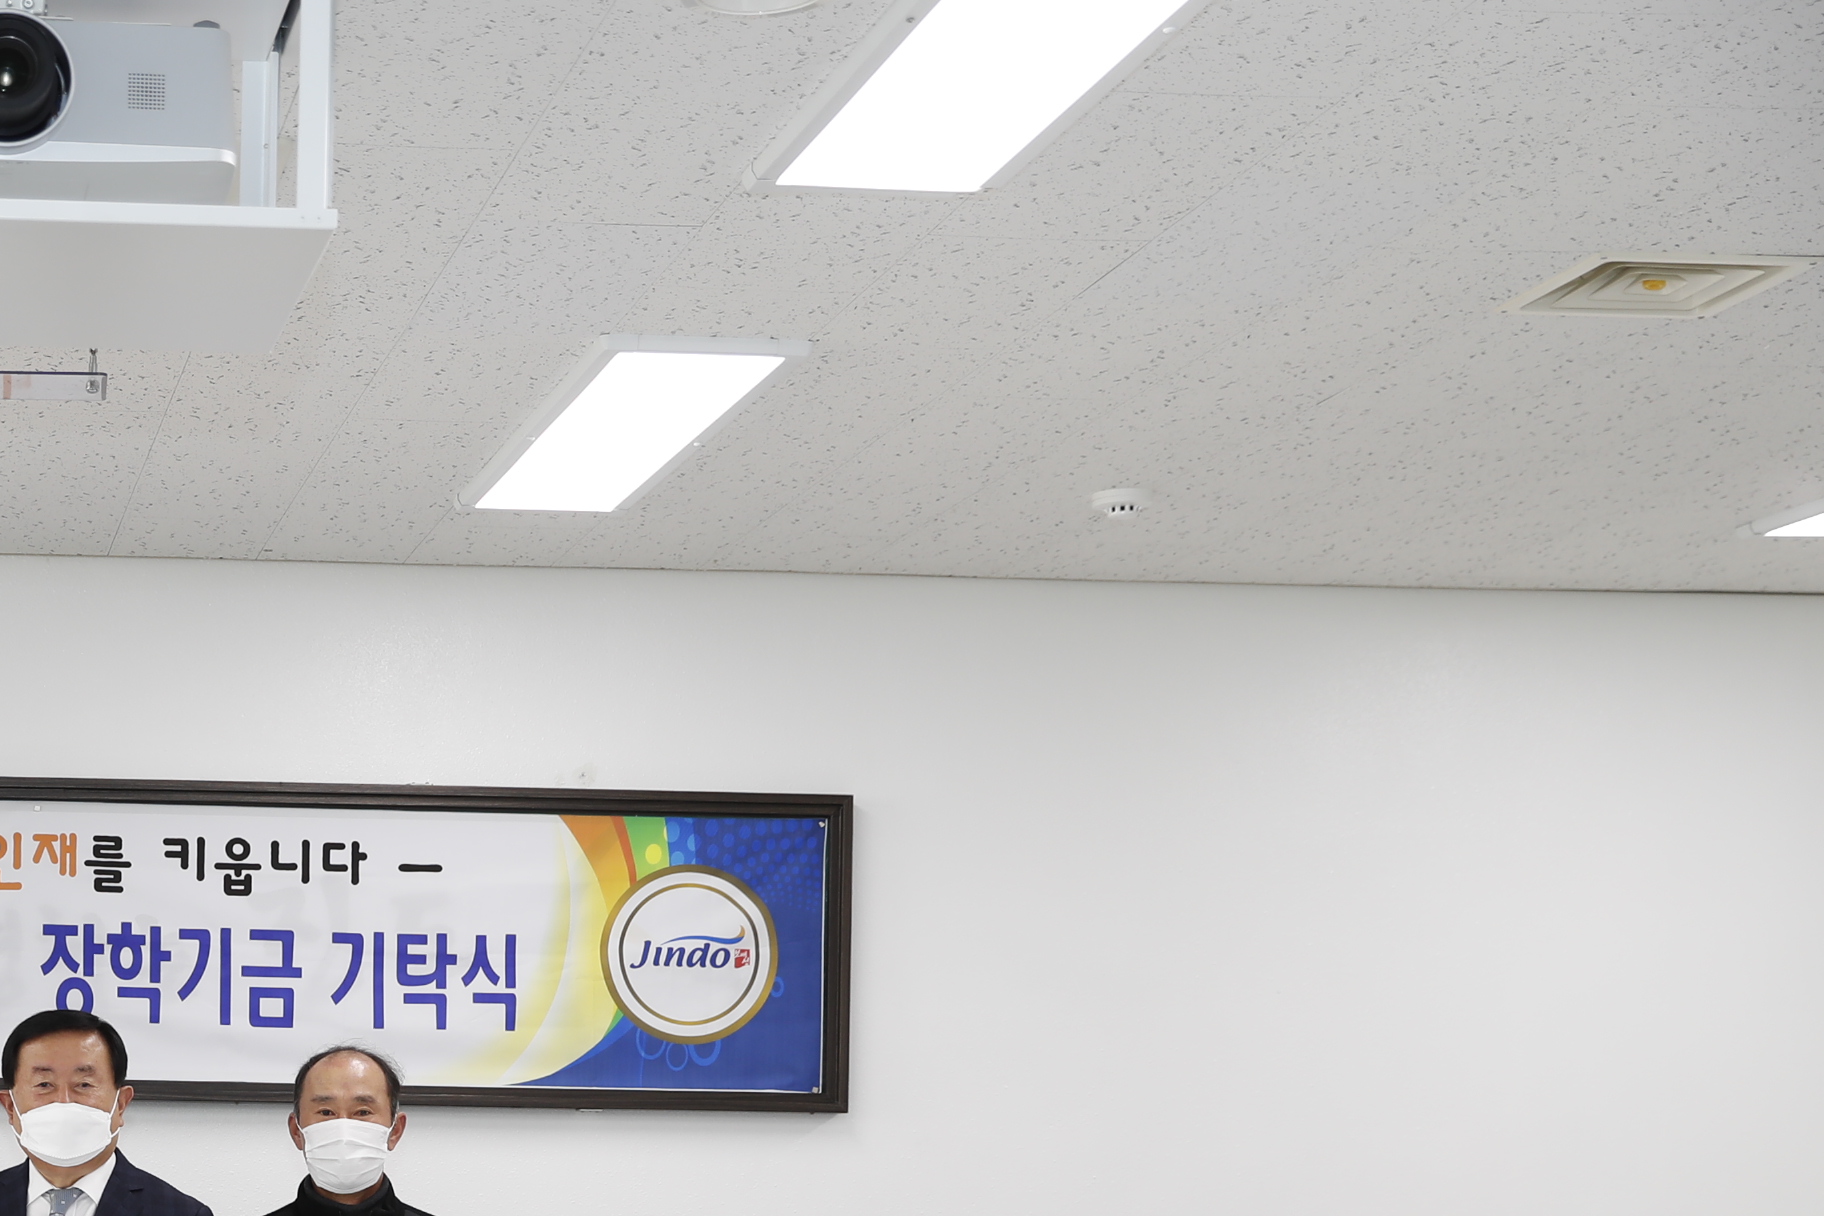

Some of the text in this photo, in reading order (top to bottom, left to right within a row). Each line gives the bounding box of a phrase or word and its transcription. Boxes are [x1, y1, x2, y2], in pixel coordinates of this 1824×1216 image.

[162, 836, 368, 897] 키웁니다
[40, 921, 303, 1030] 장학기금
[330, 931, 517, 1032] 기탁식
[629, 940, 731, 969] Jindo
